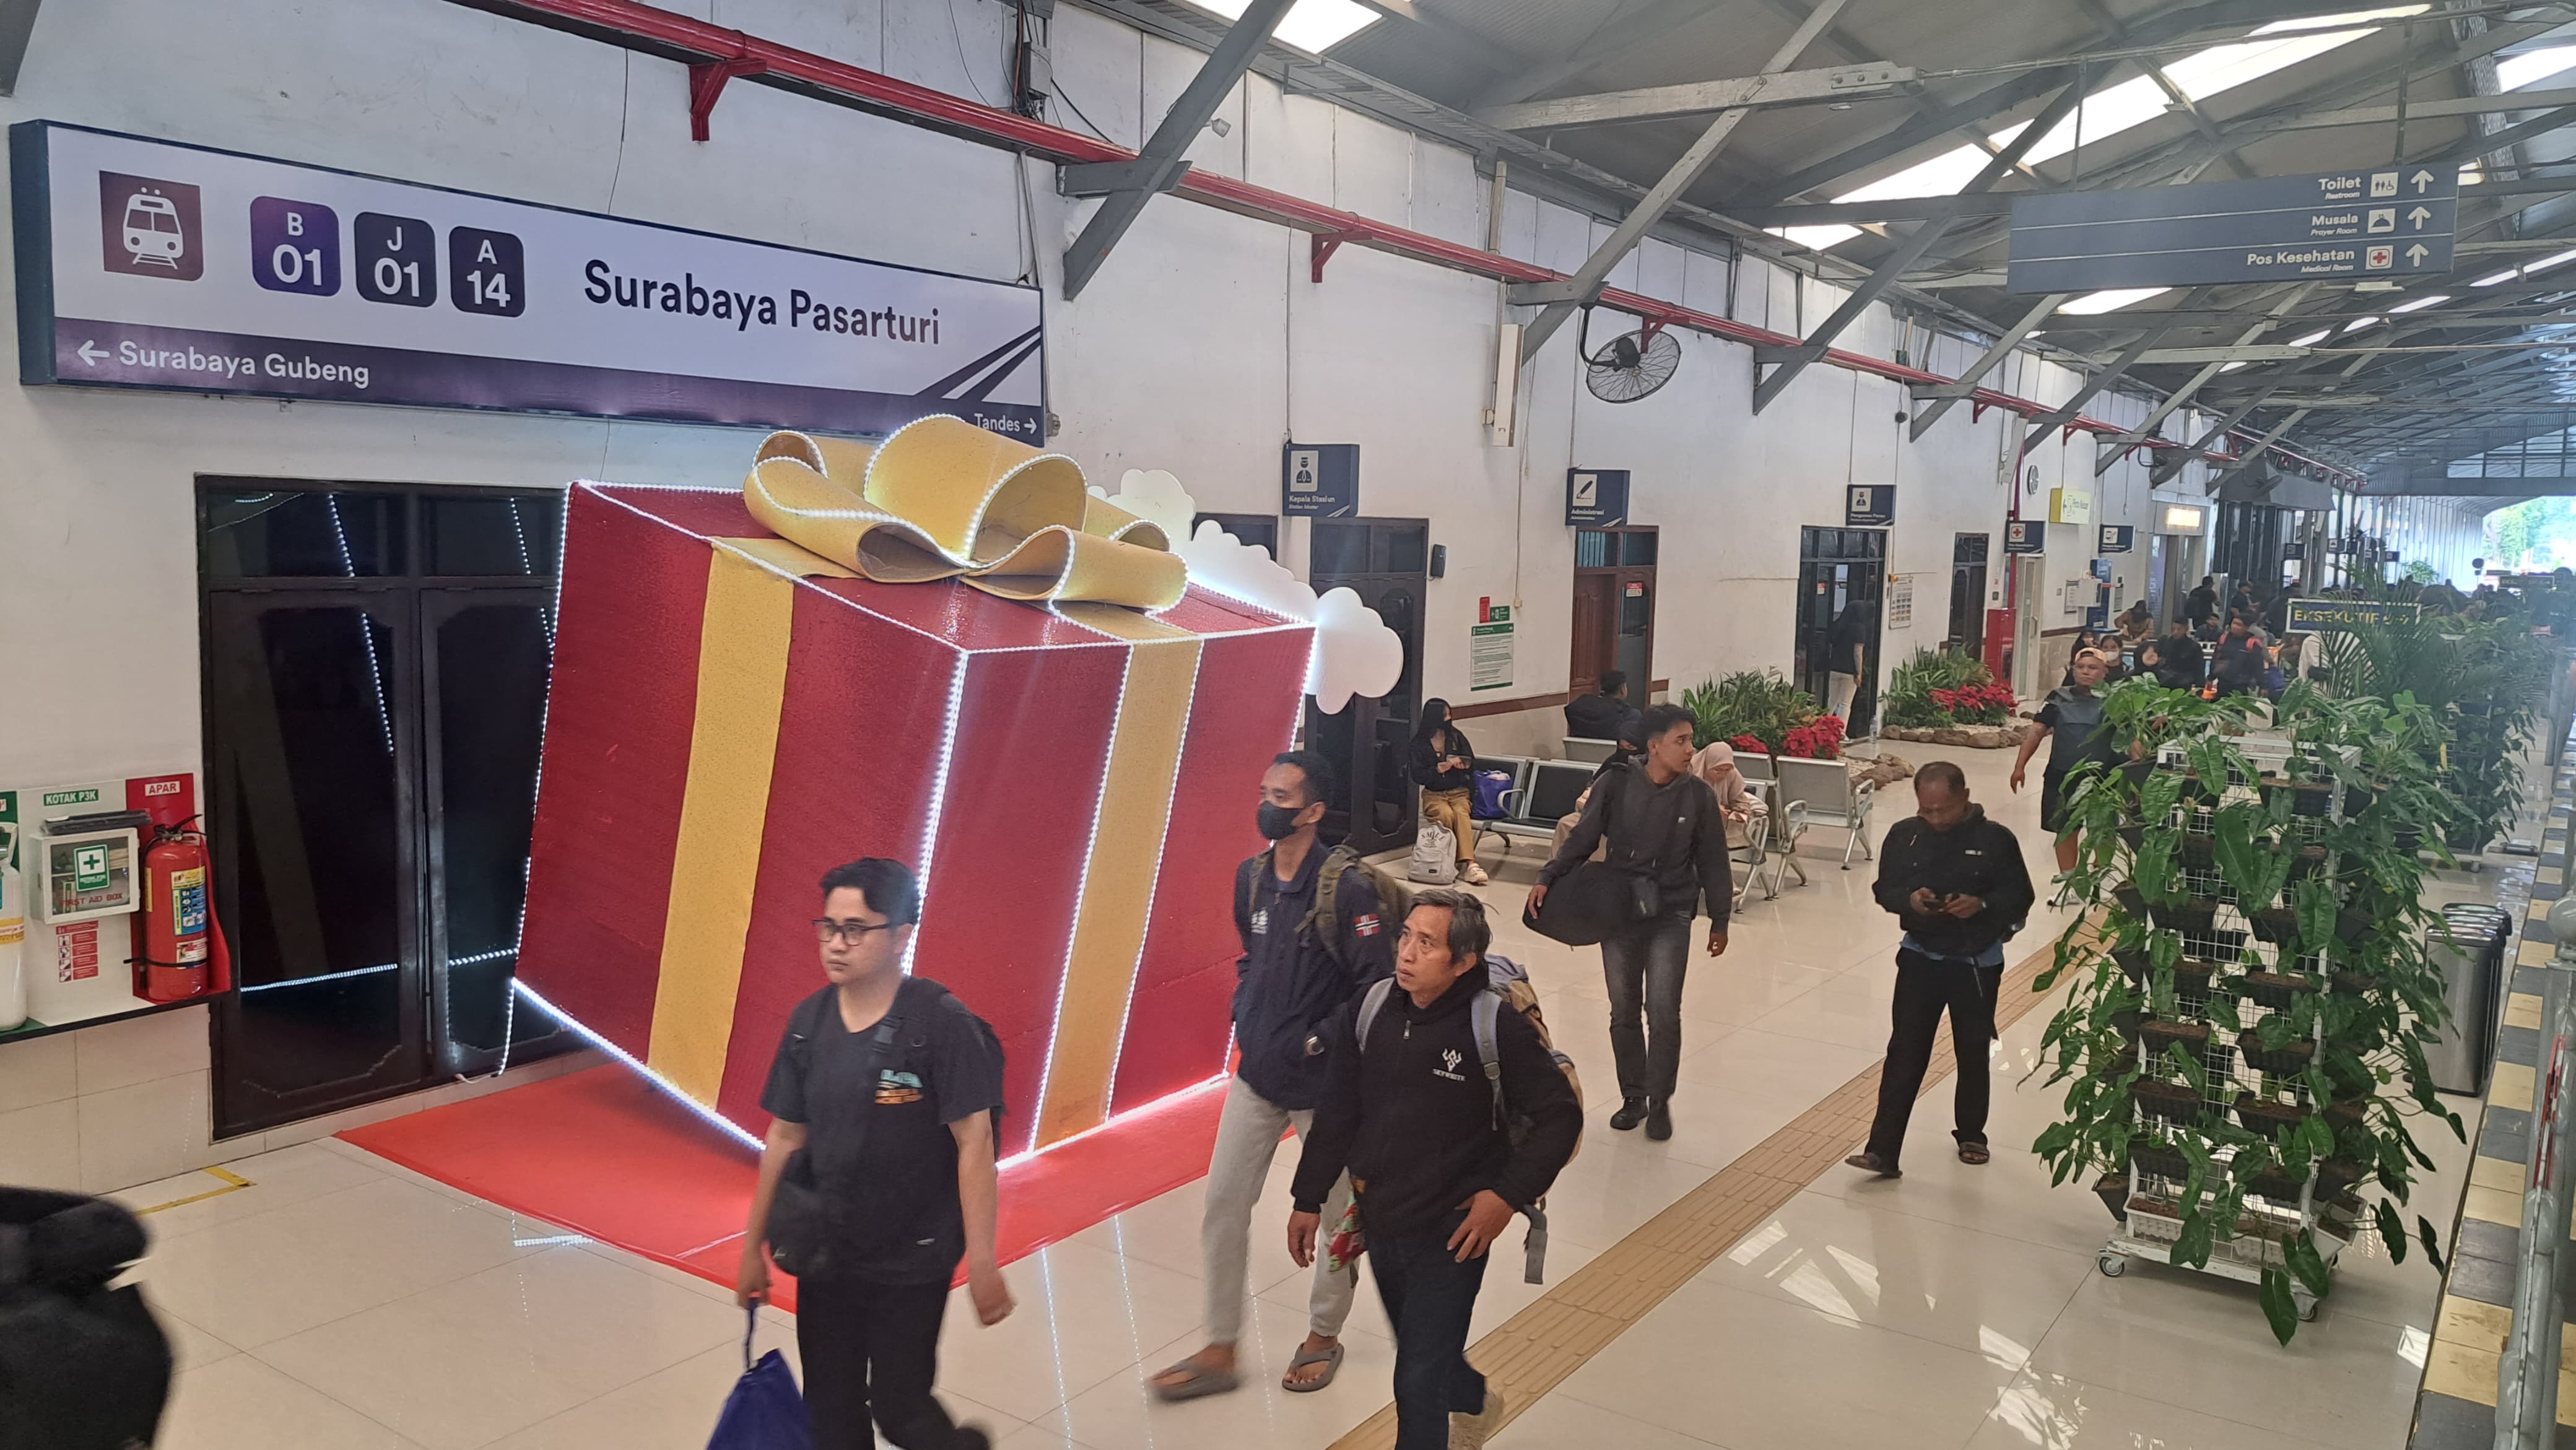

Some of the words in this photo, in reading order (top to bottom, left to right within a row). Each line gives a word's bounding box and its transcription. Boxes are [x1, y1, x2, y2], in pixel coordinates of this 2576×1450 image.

[2318, 176, 2361, 191] Toilet
[2325, 191, 2360, 199] Restroom
[287, 212, 304, 237] B
[2312, 213, 2358, 226] Musala
[386, 226, 402, 251] J
[2310, 228, 2335, 237] Prayer
[2336, 227, 2357, 235] Room
[477, 239, 497, 264] A
[2247, 253, 2273, 266] Pos
[2276, 250, 2355, 264] Kesehatan
[272, 244, 322, 286] 01
[2300, 265, 2331, 274] Medical
[2332, 264, 2354, 272] Room
[374, 257, 420, 297] 01
[467, 270, 511, 307] 14
[585, 259, 777, 331] Surabaya
[790, 289, 939, 345] Pasarturi
[119, 341, 256, 379] Surabaya
[264, 353, 370, 389] Gubeng
[974, 413, 1020, 432] Tandes
[1289, 495, 1310, 503] Kepala
[149, 783, 177, 794] APAR
[45, 792, 77, 805] KOTAK
[79, 791, 97, 801] P3K
[59, 898, 85, 907] FIRST
[89, 895, 103, 903] AID
[107, 893, 123, 901] BOX
